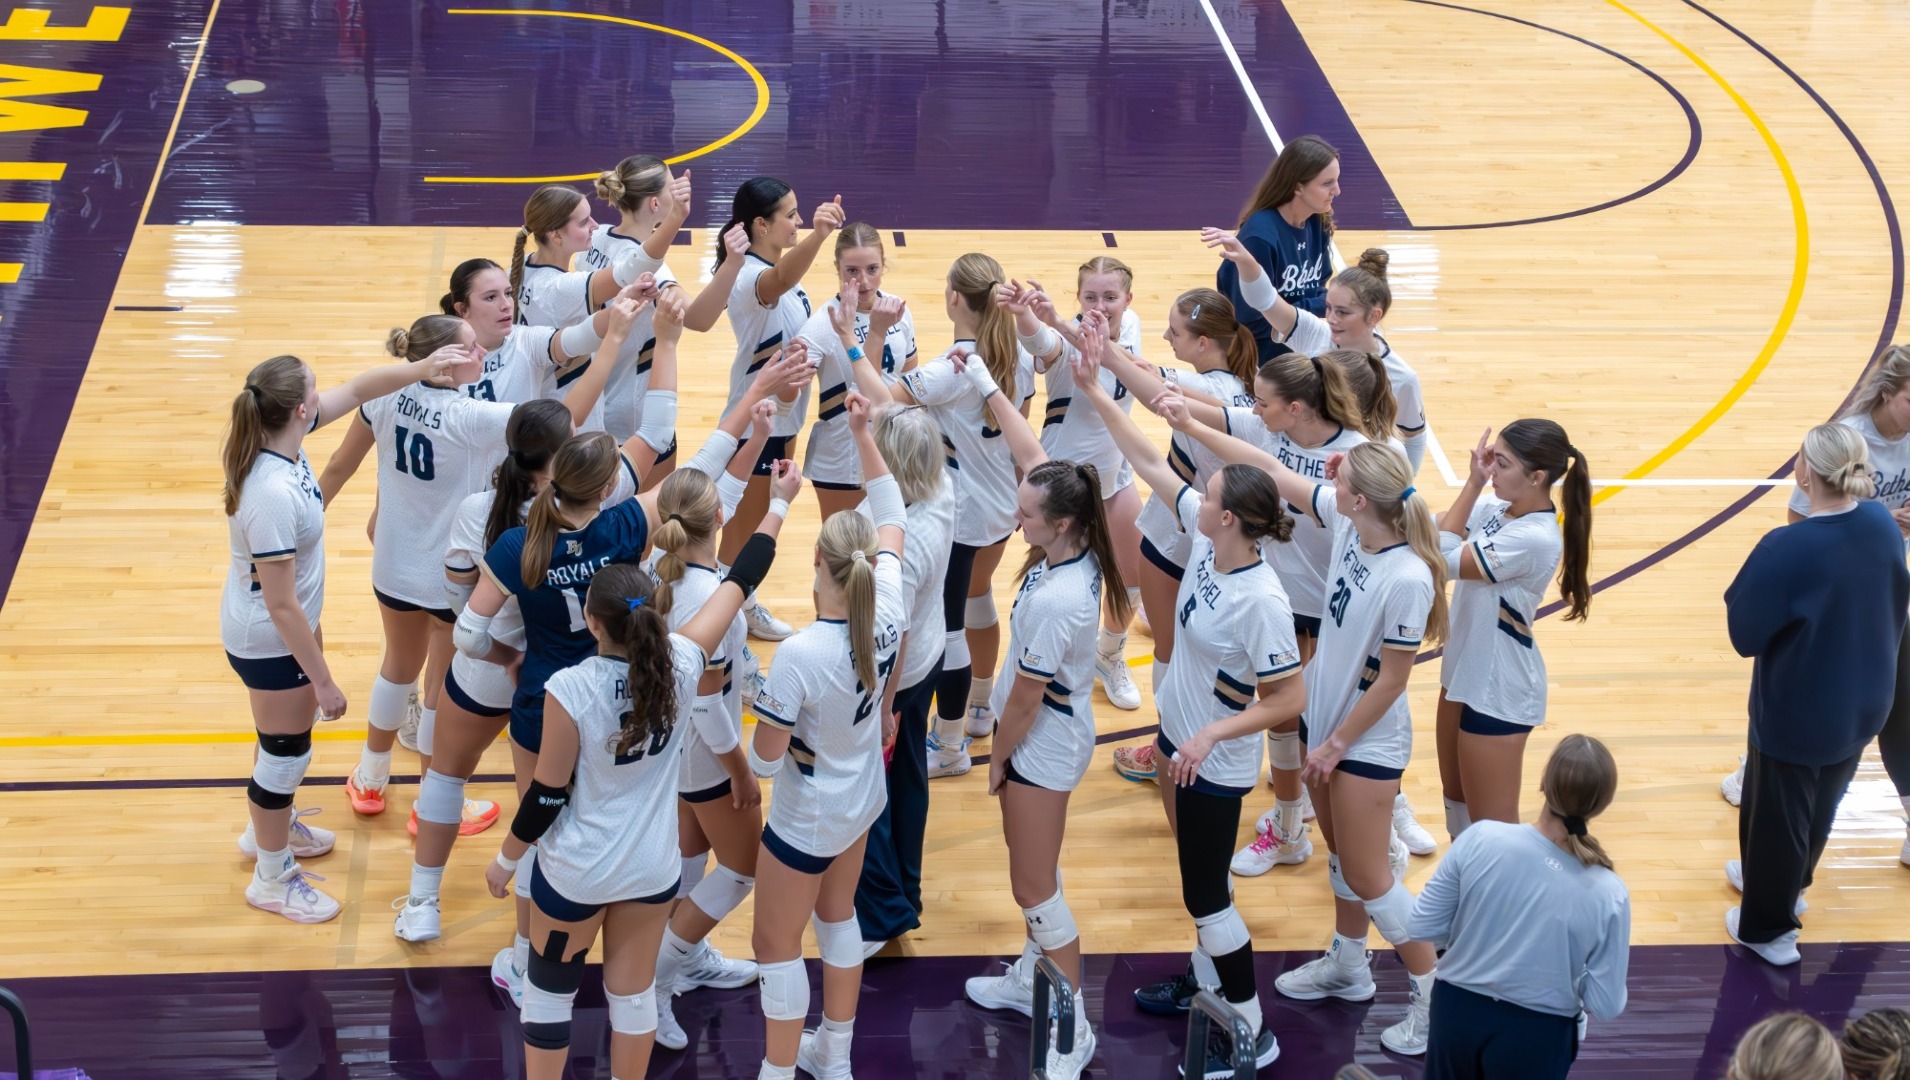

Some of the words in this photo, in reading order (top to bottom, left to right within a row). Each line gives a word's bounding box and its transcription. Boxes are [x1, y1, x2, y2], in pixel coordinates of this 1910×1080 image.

[1278, 252, 1322, 292] Behel
[396, 393, 441, 429] ROYALS
[395, 425, 435, 480] 10
[1278, 447, 1334, 480] BETHE
[1329, 577, 1352, 628] 20
